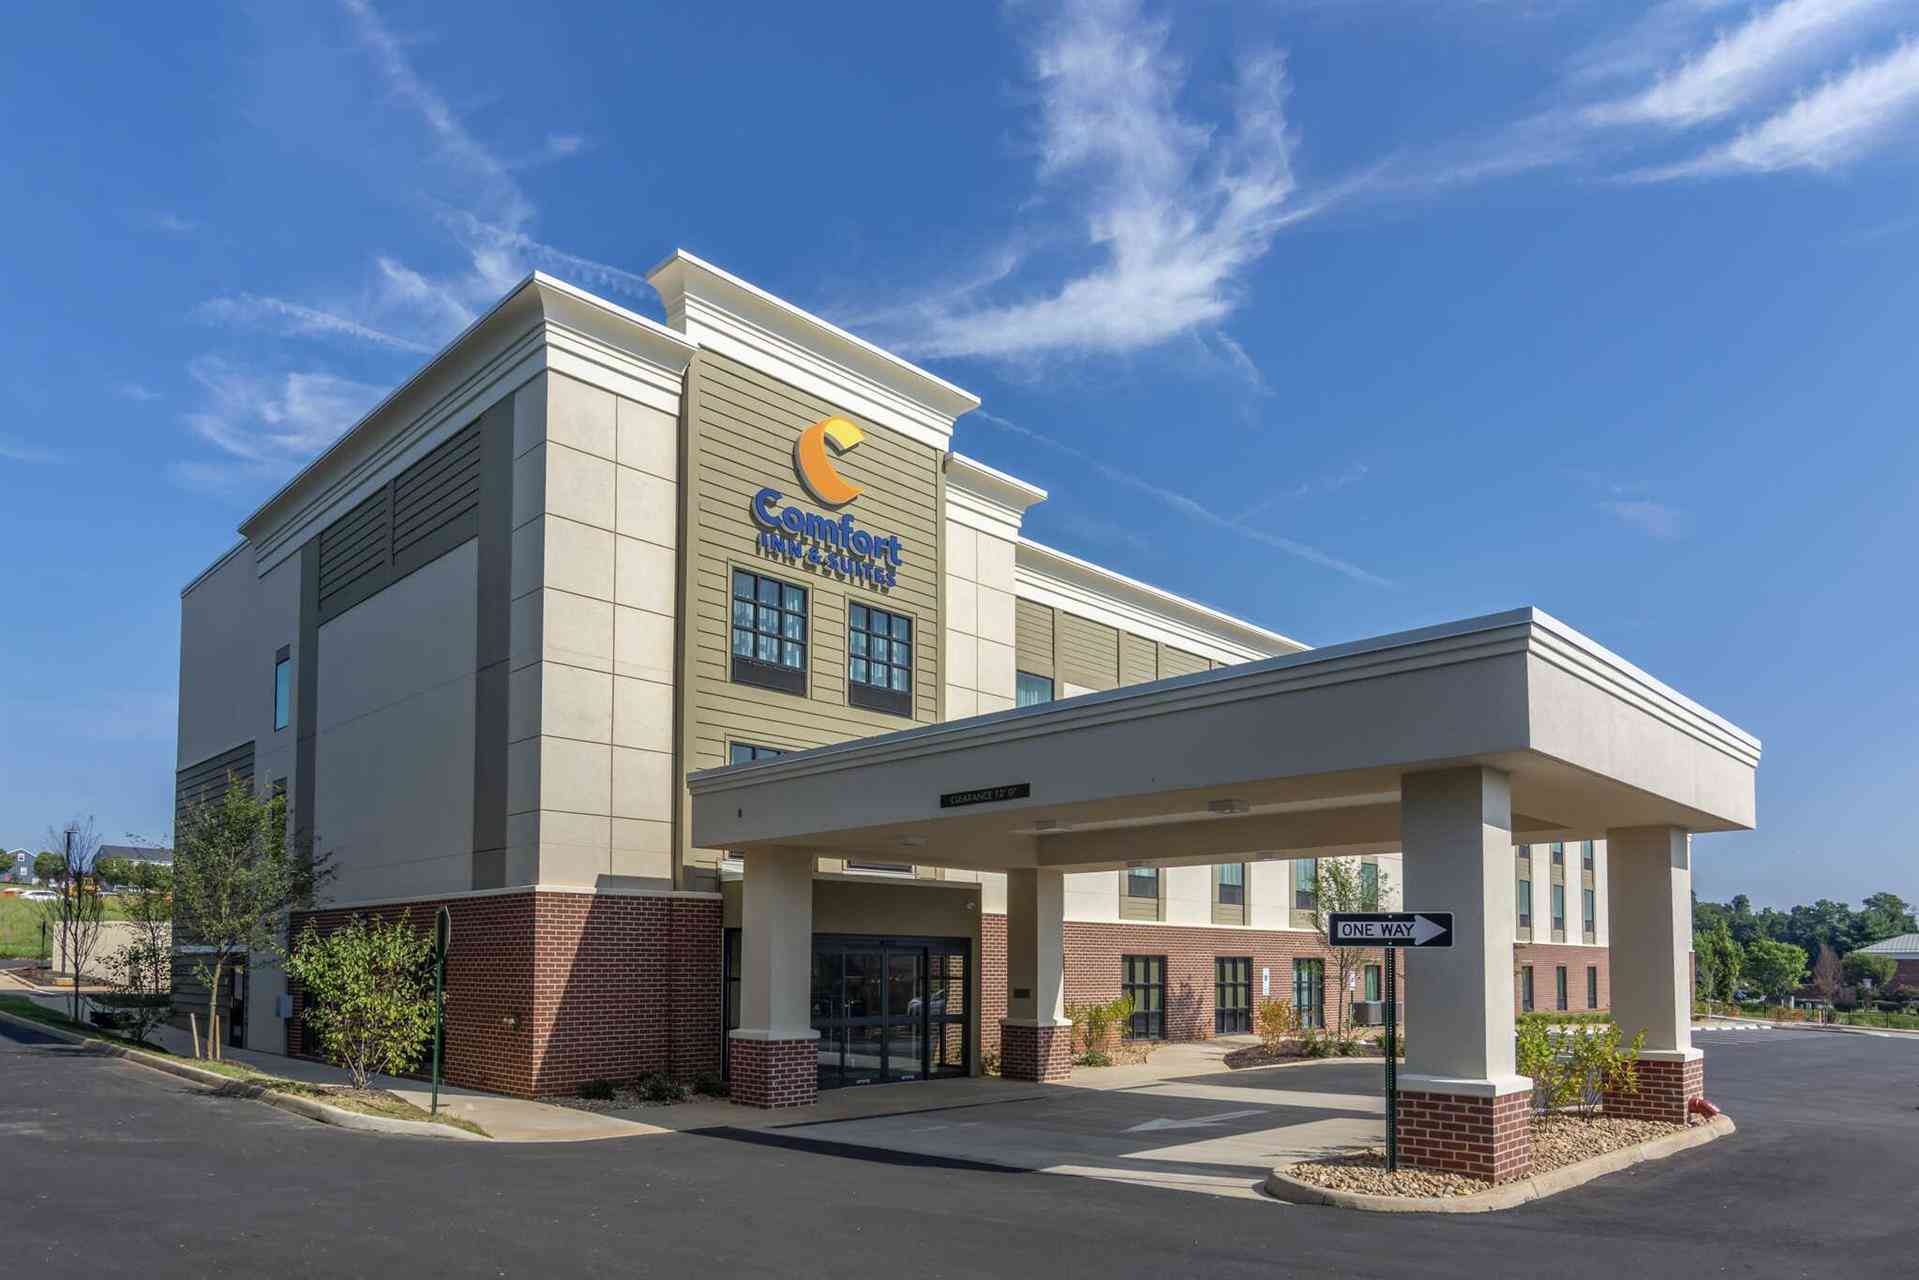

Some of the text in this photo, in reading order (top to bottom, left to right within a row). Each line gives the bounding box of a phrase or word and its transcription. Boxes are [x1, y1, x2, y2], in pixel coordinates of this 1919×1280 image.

[751, 488, 903, 567] Comfort
[757, 531, 897, 589] INN & SUITES
[1342, 923, 1415, 937] ONE WAY
